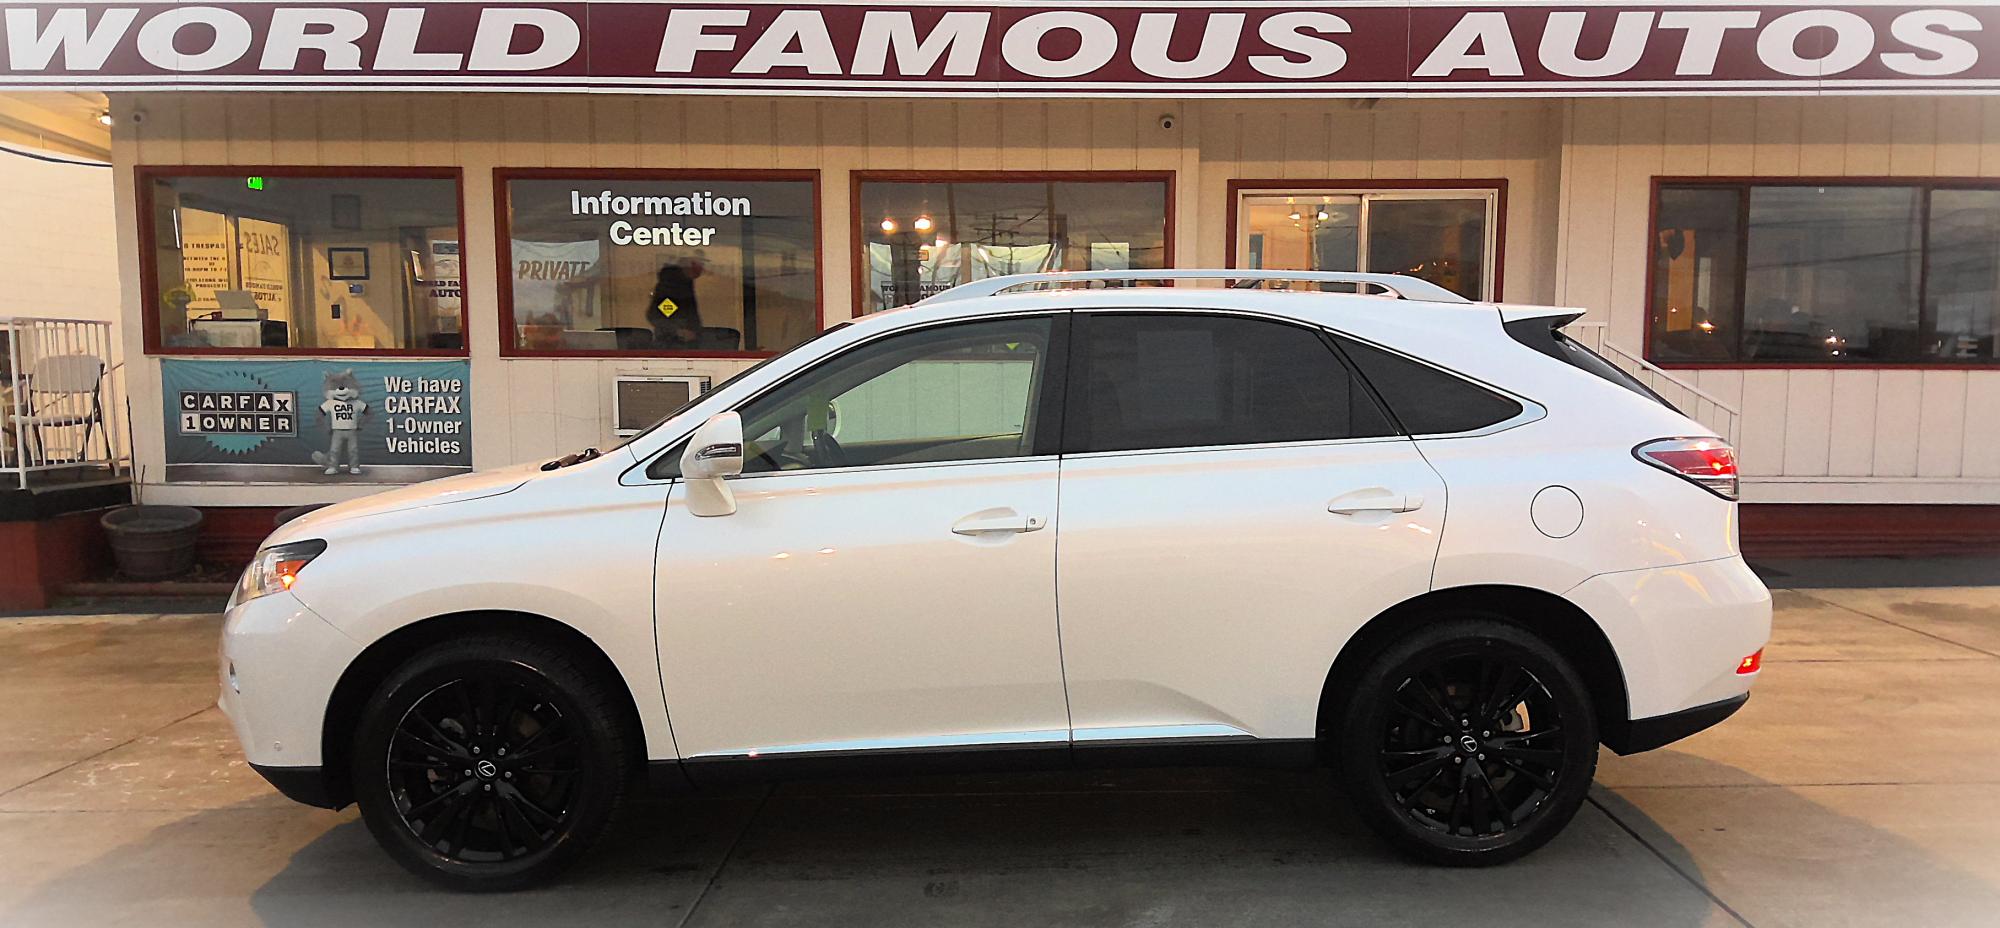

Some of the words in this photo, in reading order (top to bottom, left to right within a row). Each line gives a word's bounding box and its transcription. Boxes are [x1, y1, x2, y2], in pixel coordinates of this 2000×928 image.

[5, 8, 580, 71] WORLD
[656, 9, 1351, 78] FAMOUS
[1412, 9, 1983, 77] AUTOS
[571, 190, 750, 216] Information
[609, 221, 716, 246] Center
[384, 376, 412, 393] We
[418, 376, 461, 393] have
[183, 393, 291, 412] CARFAX
[334, 404, 354, 413] CAR
[384, 396, 461, 414] CARFAX
[336, 412, 353, 421] FOX
[386, 417, 462, 434] 1-Owner
[385, 437, 461, 454] Vehicles
